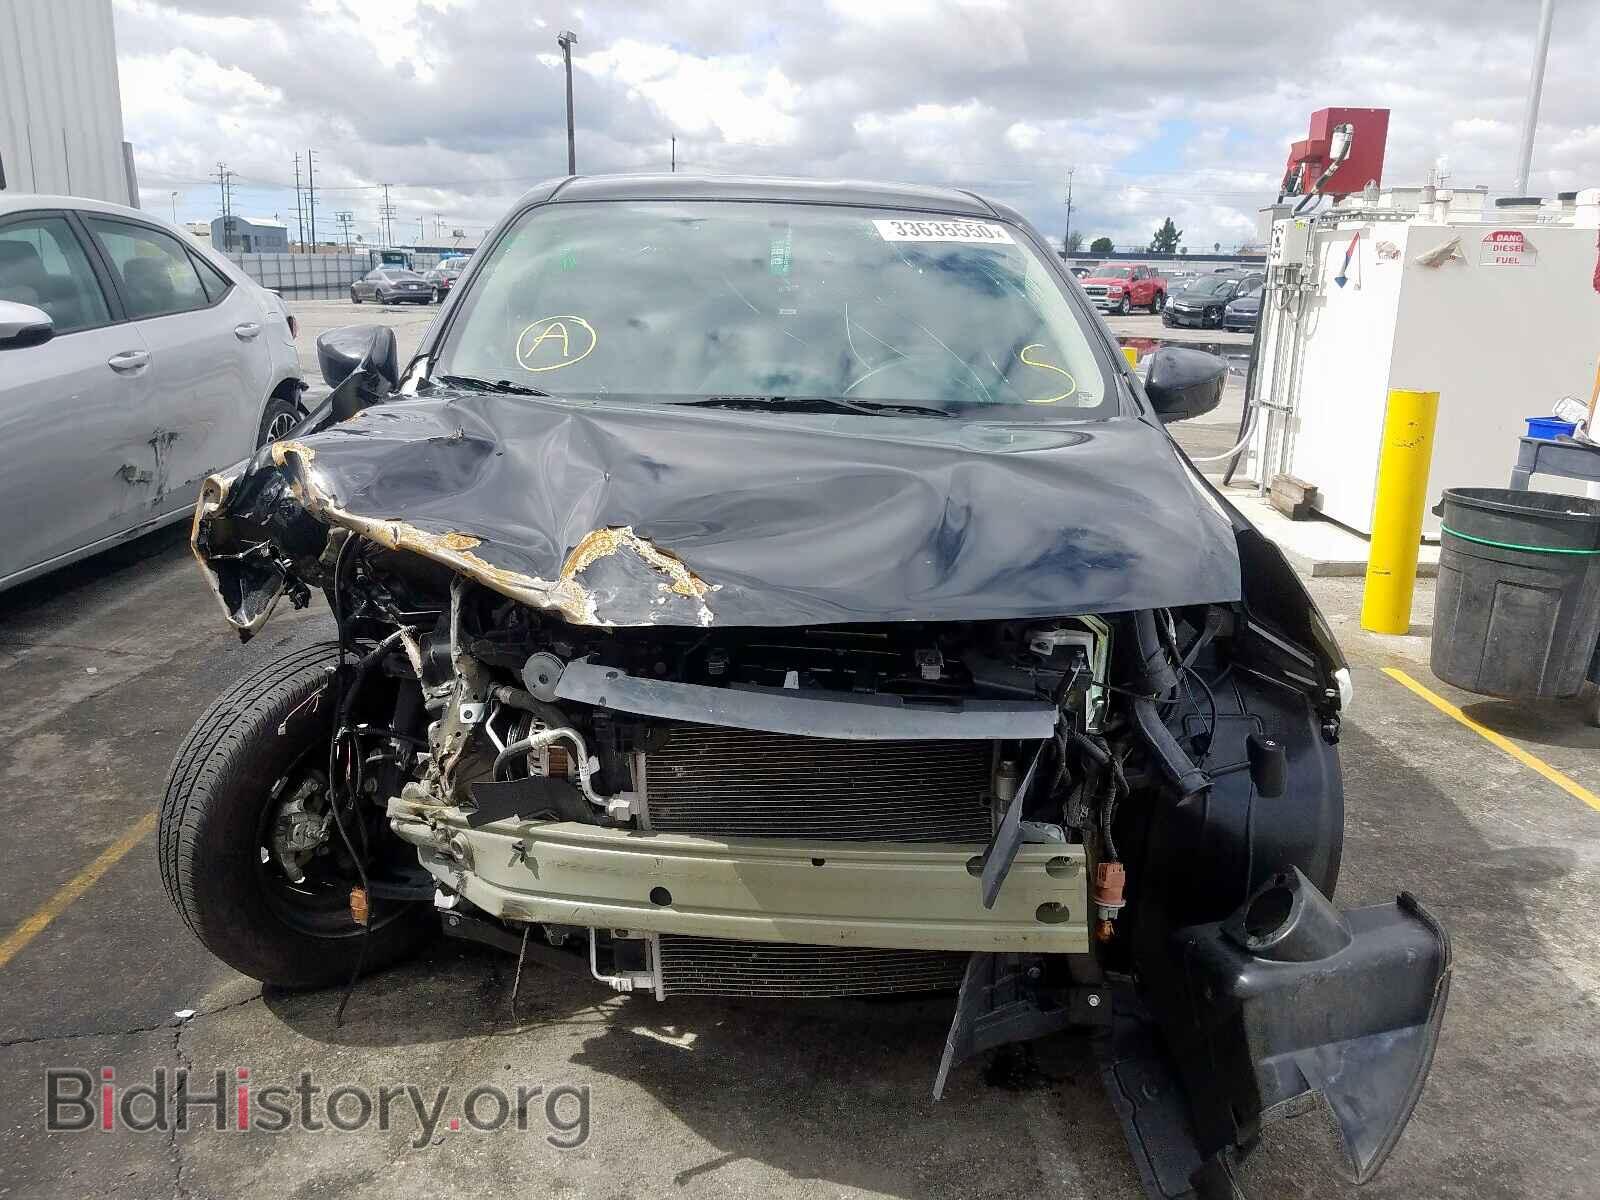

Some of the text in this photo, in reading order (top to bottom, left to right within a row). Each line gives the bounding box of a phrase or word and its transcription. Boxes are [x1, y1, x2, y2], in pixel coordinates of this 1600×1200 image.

[1495, 256, 1520, 264] FUEL
[525, 322, 569, 358] A
[1020, 343, 1076, 403] S
